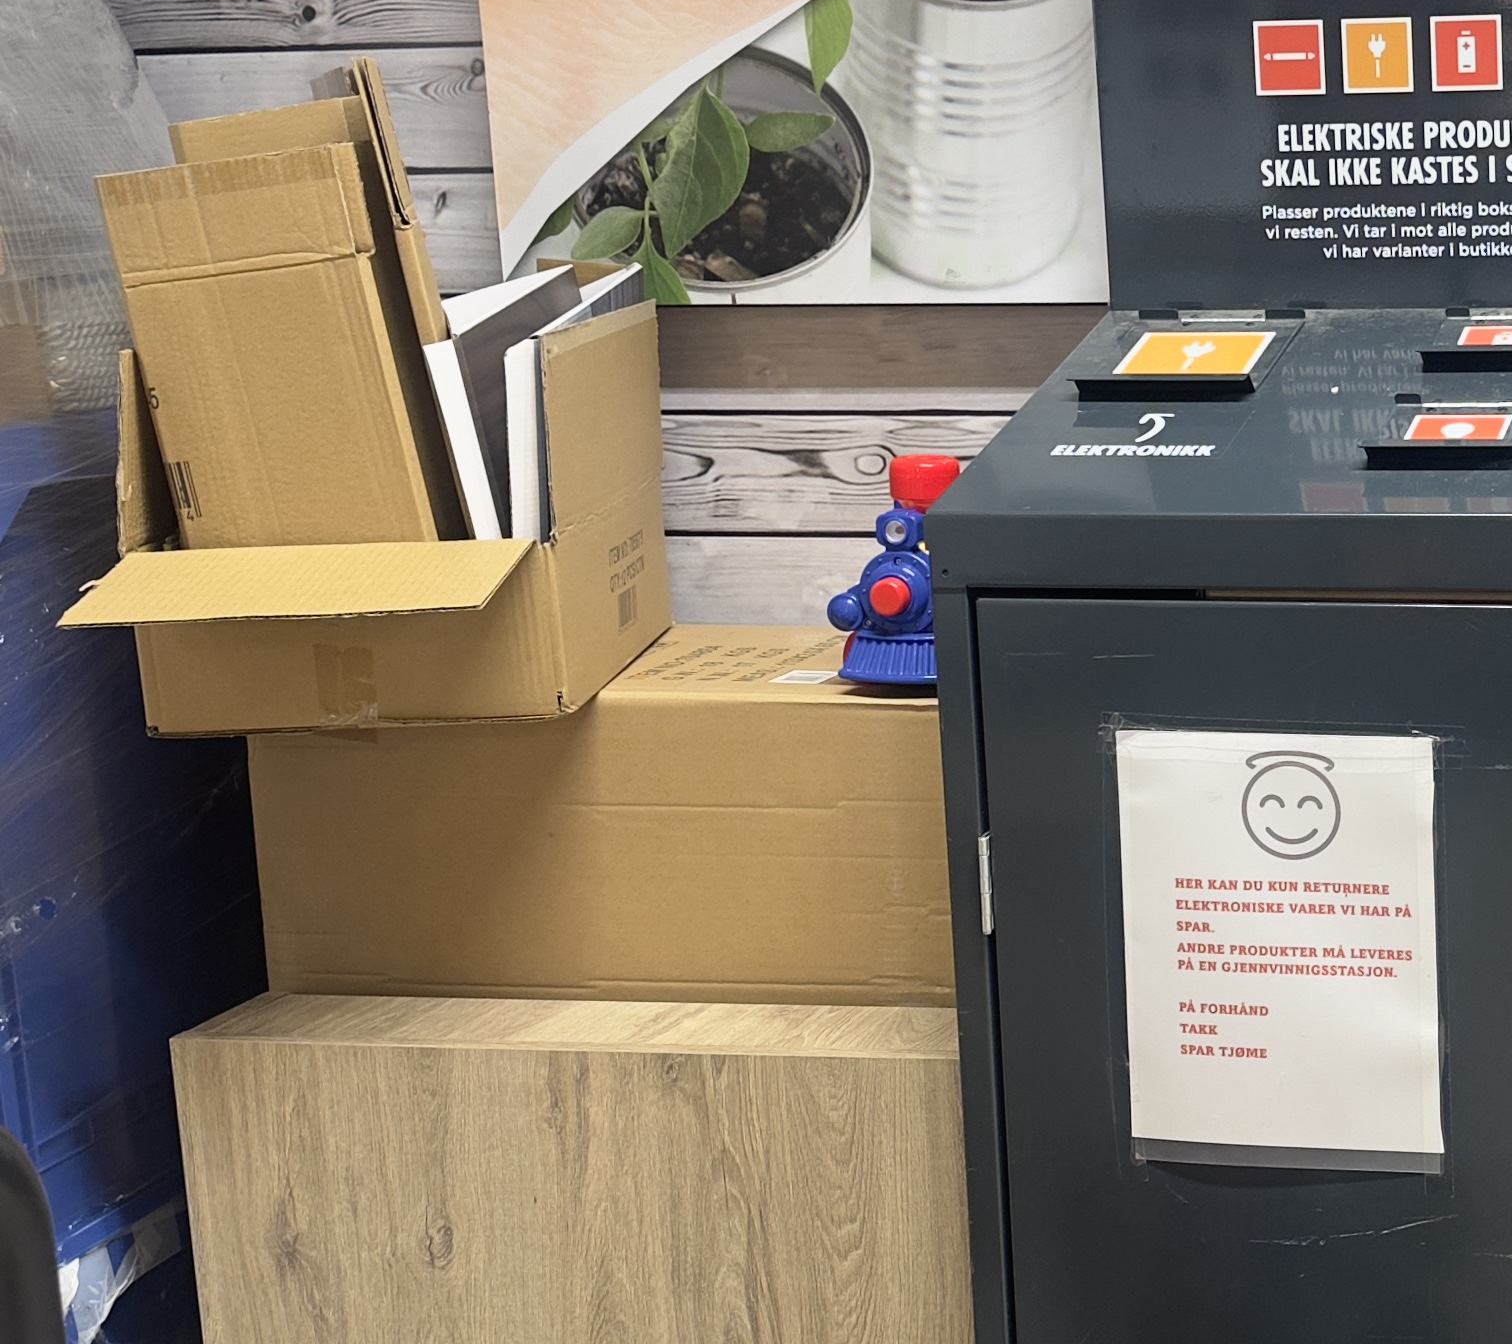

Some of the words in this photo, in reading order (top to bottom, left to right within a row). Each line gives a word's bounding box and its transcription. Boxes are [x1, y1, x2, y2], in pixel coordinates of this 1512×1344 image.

[1278, 122, 1414, 152] ELEKTRISKE
[1261, 159, 1319, 186] SKAL
[1329, 158, 1382, 185] IKKE
[1391, 156, 1478, 185] KASTES
[1488, 156, 1496, 182] I
[1262, 205, 1318, 220] Plasser
[1324, 205, 1416, 221] produktene
[1421, 203, 1425, 217] i
[1431, 202, 1473, 218] riktig
[1265, 226, 1279, 239] vi
[1285, 226, 1338, 239] resten.
[1343, 224, 1359, 238] Vi
[1364, 225, 1387, 238] tar
[1392, 224, 1396, 238] i
[1401, 225, 1433, 238] mot
[1438, 222, 1466, 237] alle
[1324, 244, 1337, 258] vi
[1343, 243, 1367, 258] har
[1373, 242, 1445, 257] varianter
[1450, 242, 1454, 256] i
[1050, 445, 1216, 456] ELEKTRONIKK
[1175, 878, 1203, 889] HER
[1208, 879, 1238, 891] KAN
[1243, 880, 1263, 891] DU
[1268, 881, 1298, 892] KUN
[1303, 882, 1390, 895] RETURNERE
[1176, 900, 1284, 913] ELEKTRONISKE
[1289, 903, 1336, 915] VARER
[1341, 905, 1355, 916] VI
[1361, 905, 1390, 917] HAR
[1395, 904, 1411, 918] PÅ
[1177, 921, 1215, 933] SPAR.
[1177, 943, 1224, 954] ANDRE
[1230, 944, 1317, 958] PRODUKTER
[1323, 945, 1345, 959] MÅ
[1350, 948, 1413, 961] LEVERES
[1178, 957, 1194, 971] PÅ
[1199, 961, 1216, 972] EN
[1222, 962, 1397, 978] GJENNVINNIGSSTASJON.
[1179, 999, 1195, 1012] PÅ
[1200, 1002, 1268, 1016] FORHÅND
[1180, 1023, 1218, 1035] TAKK
[1181, 1044, 1215, 1056] SPAR
[1219, 1047, 1267, 1058] TJØME
